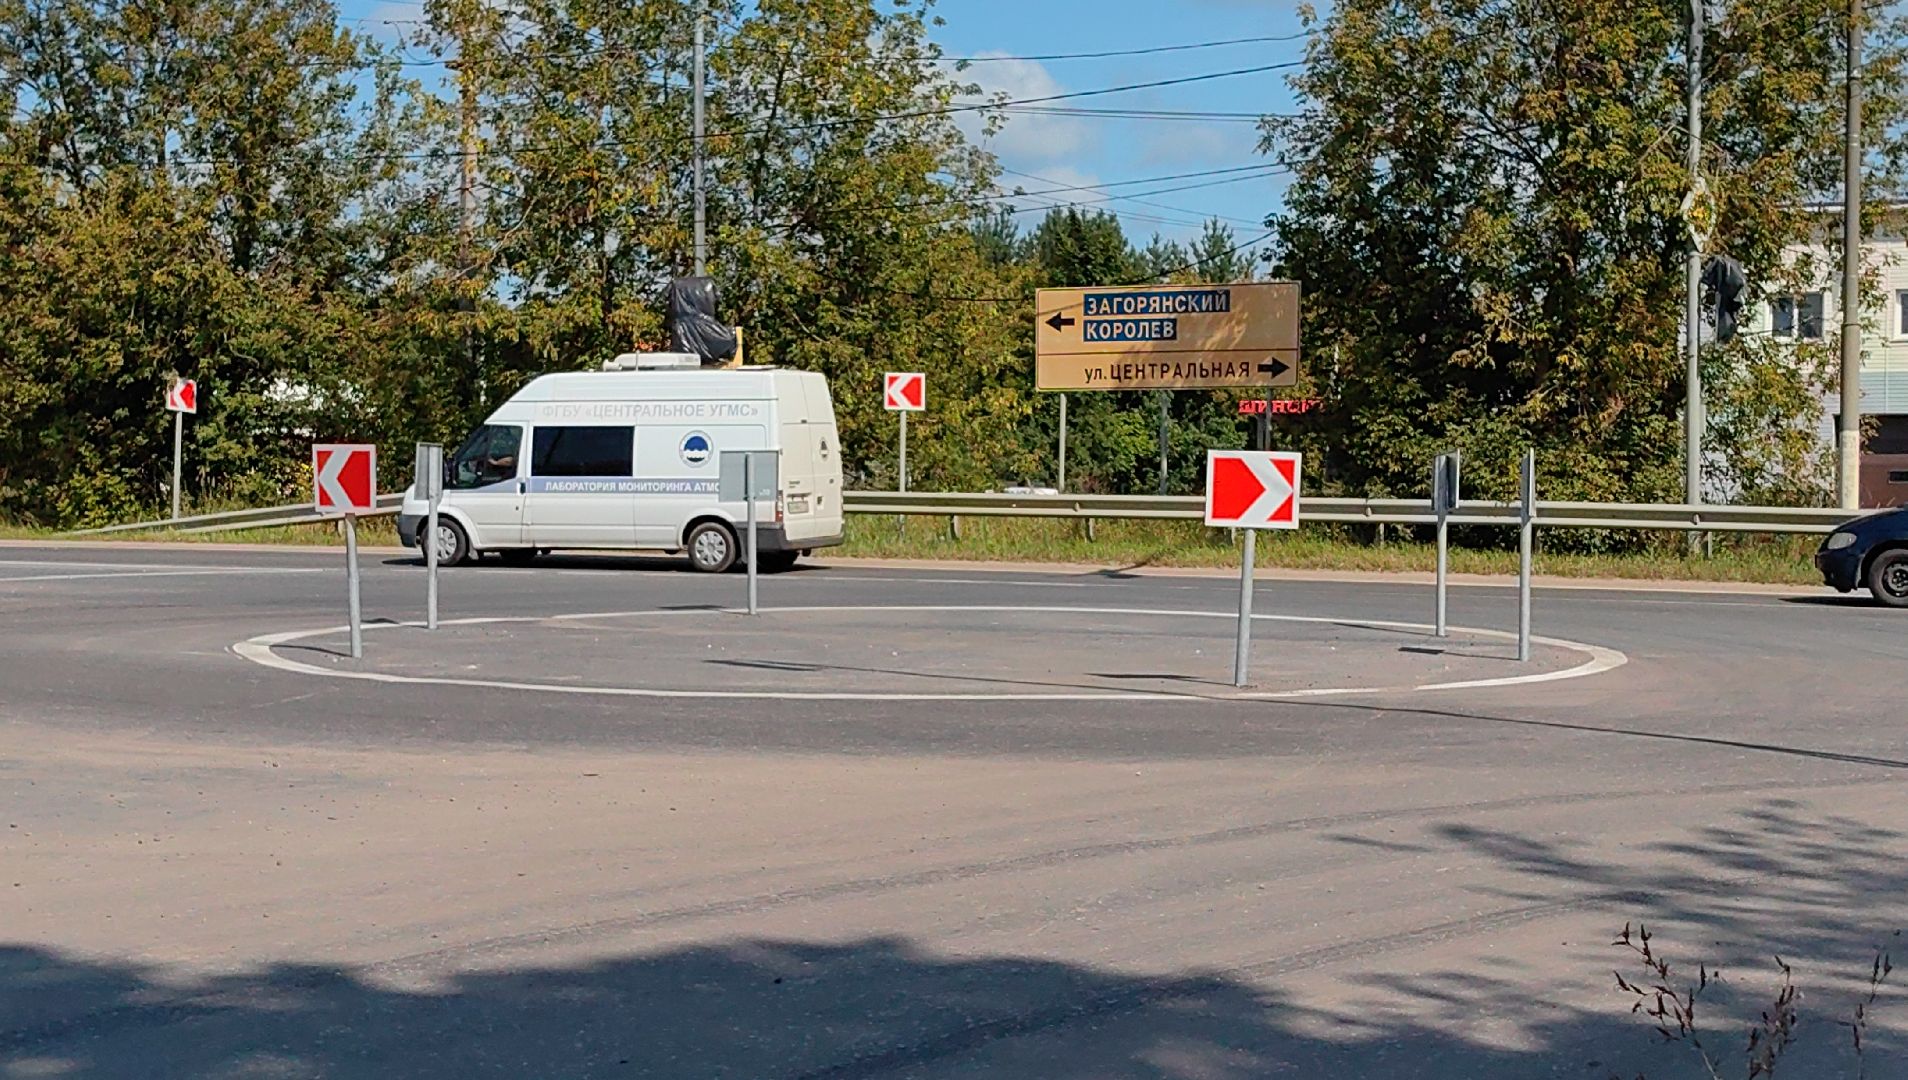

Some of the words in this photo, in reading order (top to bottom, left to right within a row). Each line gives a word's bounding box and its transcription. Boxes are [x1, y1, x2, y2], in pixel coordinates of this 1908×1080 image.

[1086, 290, 1228, 316] ЗАГОРЯНСКИЙ
[1086, 320, 1175, 340] КОРОЛЕВ
[1084, 368, 1108, 384] ул.
[1110, 362, 1251, 383] ЦЕНТРАЛЬНАЯ
[542, 404, 582, 418] ФГБУ
[585, 403, 705, 420] «ЦЕНТРАЛЬНОЕ
[709, 403, 759, 418] УГМС»
[545, 481, 616, 492] ЛАБОРАТОРИЯ
[618, 481, 693, 492] МОНИТОРИНГА
